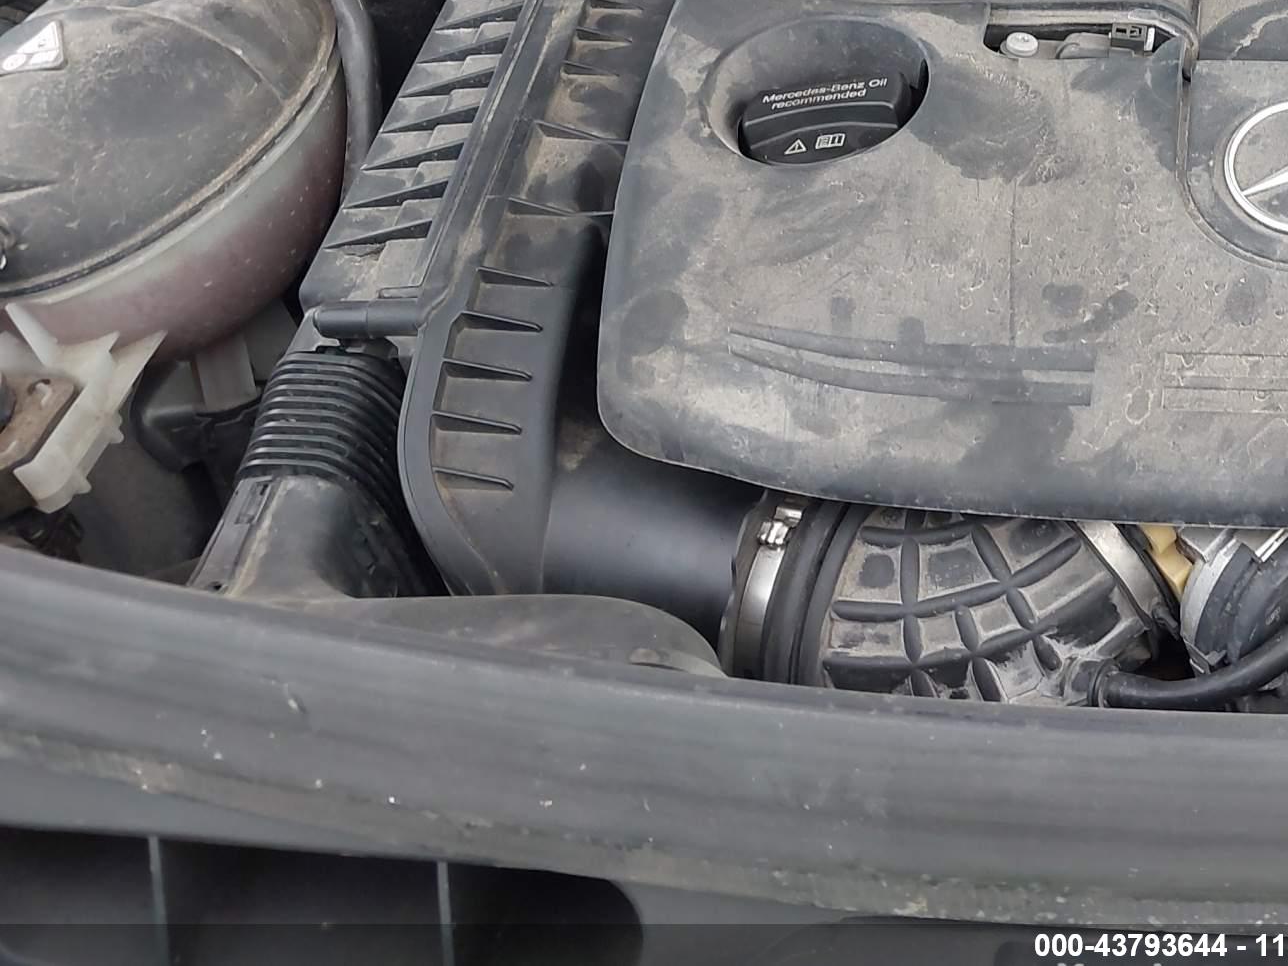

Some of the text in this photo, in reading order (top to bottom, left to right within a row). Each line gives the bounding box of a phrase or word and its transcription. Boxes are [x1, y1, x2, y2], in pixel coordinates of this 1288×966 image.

[762, 78, 888, 104] Mercedes-Benz Oil
[771, 89, 867, 110] recommended
